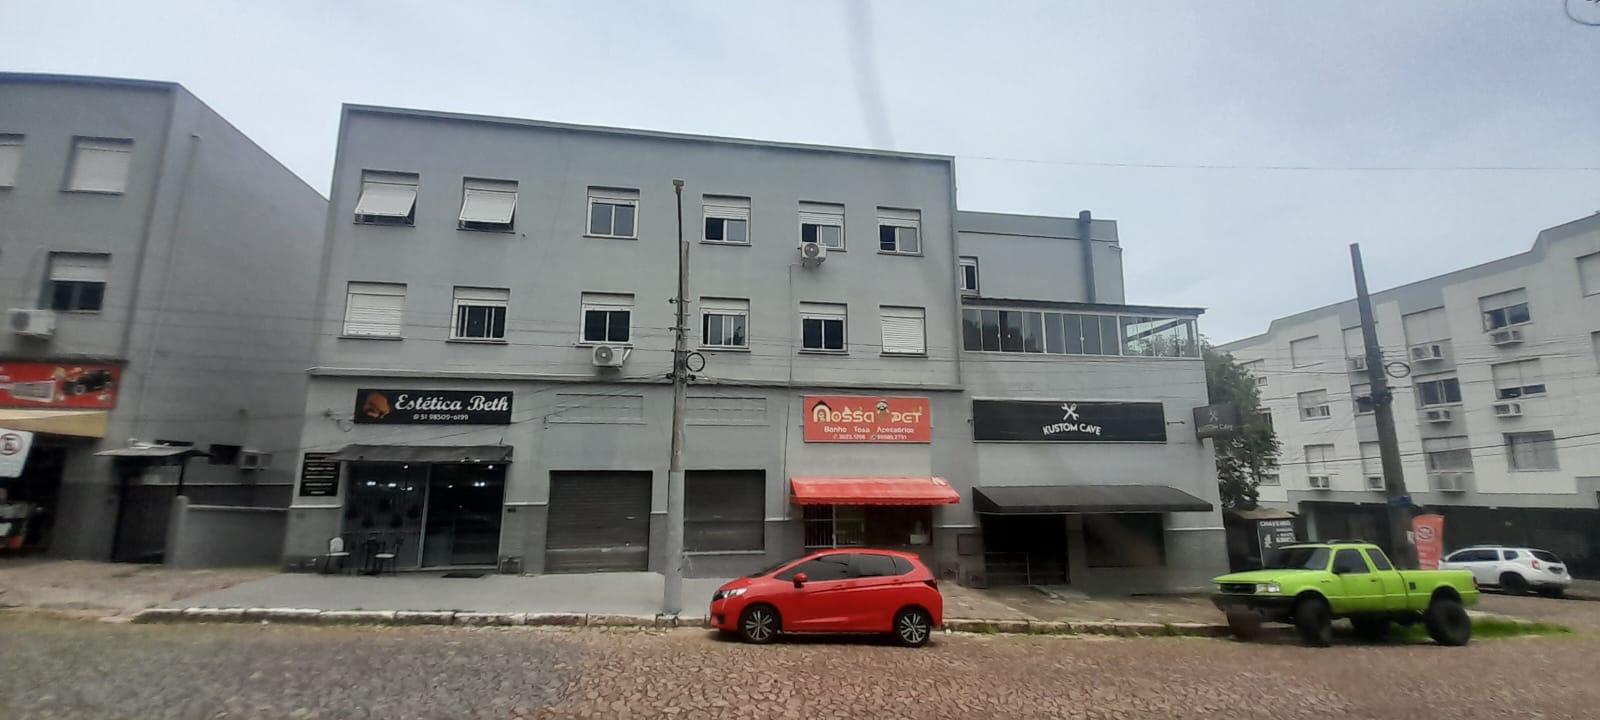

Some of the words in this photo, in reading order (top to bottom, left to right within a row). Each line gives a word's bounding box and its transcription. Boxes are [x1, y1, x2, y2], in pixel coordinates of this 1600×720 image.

[395, 394, 462, 411] Estética
[467, 395, 509, 412] Beth
[1042, 422, 1078, 436] KUSTOM
[1079, 422, 1102, 436] CAVE
